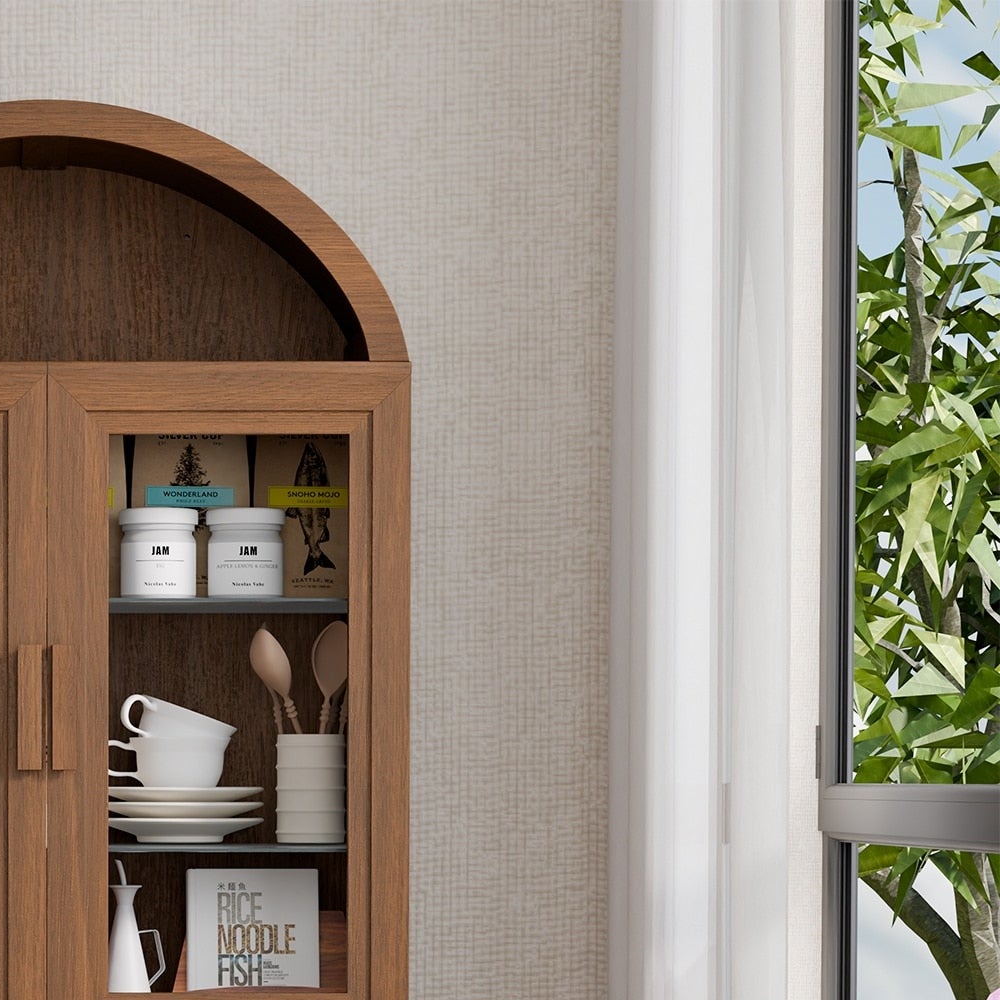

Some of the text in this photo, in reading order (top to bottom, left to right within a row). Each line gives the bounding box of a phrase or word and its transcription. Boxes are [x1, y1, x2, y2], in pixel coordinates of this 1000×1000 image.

[151, 546, 170, 556] JAM
[239, 546, 258, 556] JAM
[217, 892, 262, 924] RICE
[218, 924, 296, 954] NOODLE
[218, 954, 262, 986] FISH
